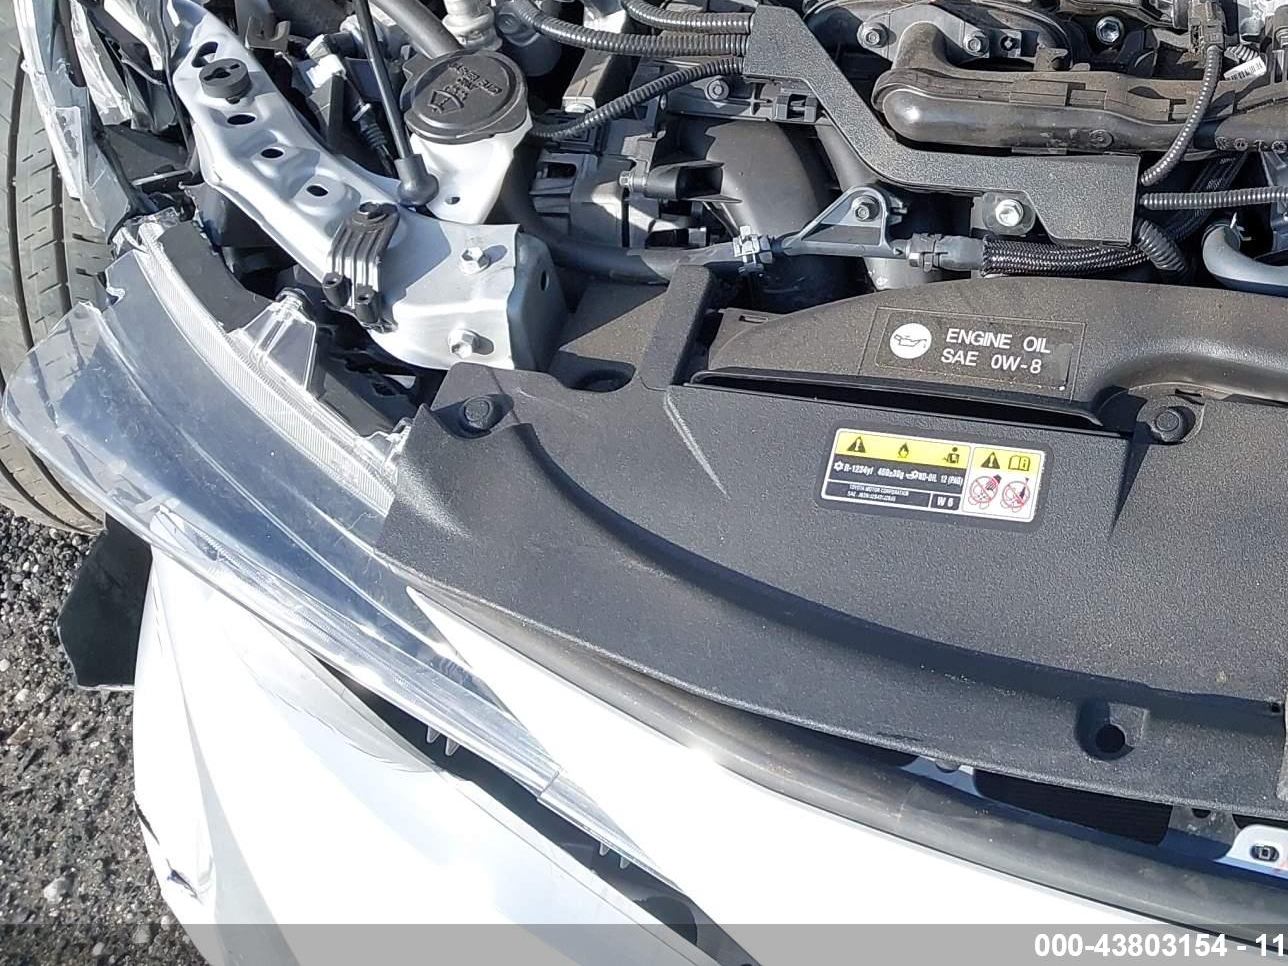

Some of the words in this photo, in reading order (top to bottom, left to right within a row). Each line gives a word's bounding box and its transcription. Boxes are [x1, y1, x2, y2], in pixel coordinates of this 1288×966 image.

[946, 328, 1012, 350] ENGINE
[1022, 336, 1051, 354] OIL
[940, 349, 977, 366] SAE
[990, 354, 1042, 374] 0W-8
